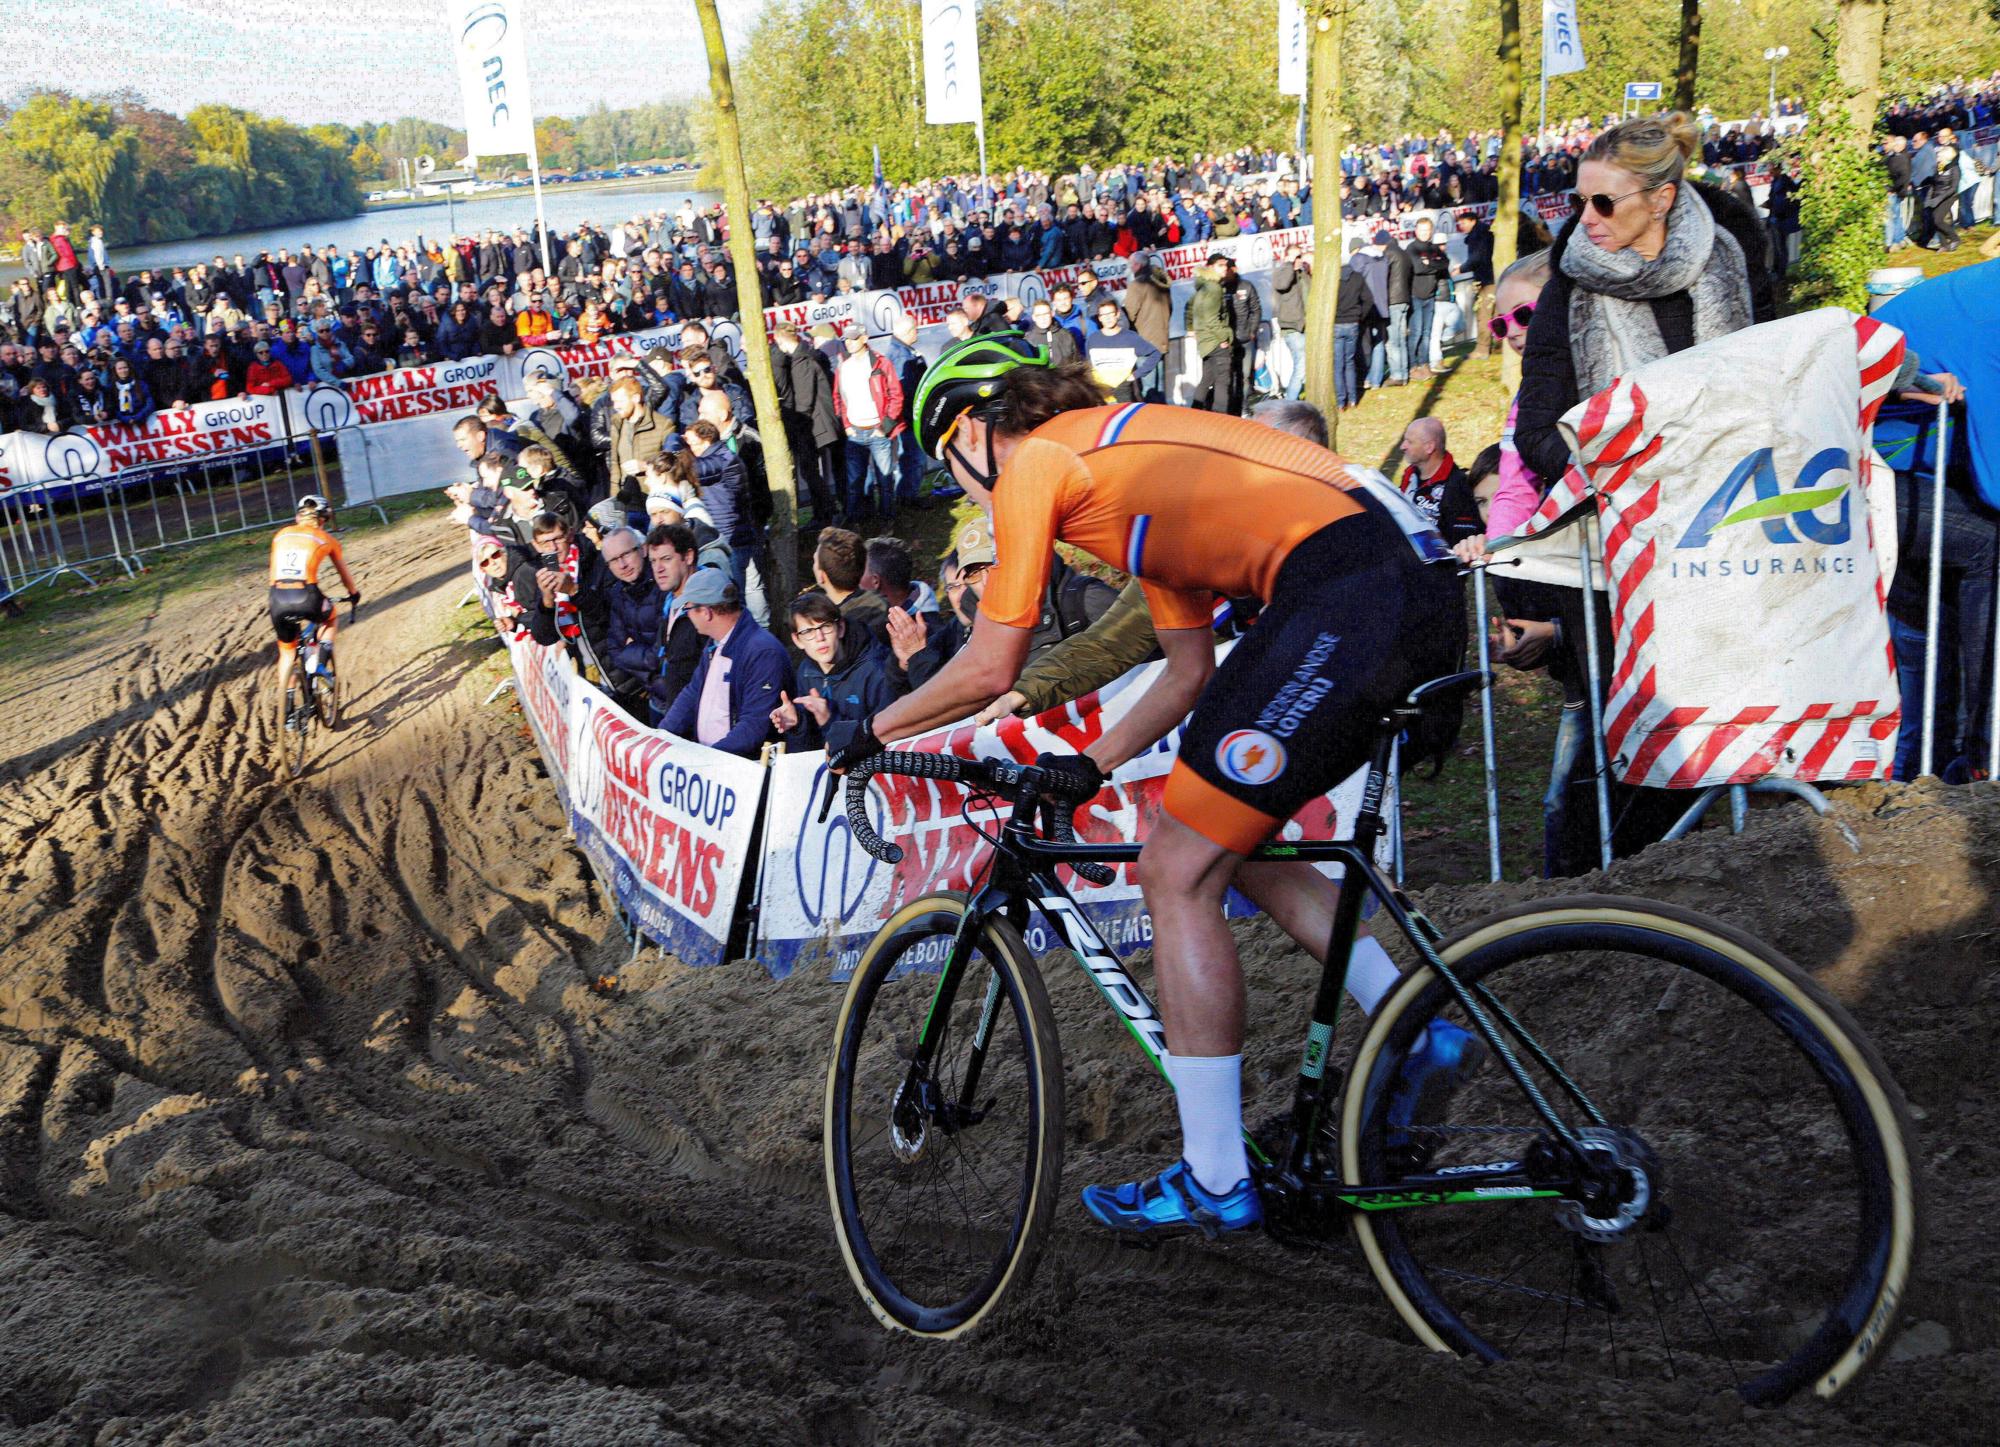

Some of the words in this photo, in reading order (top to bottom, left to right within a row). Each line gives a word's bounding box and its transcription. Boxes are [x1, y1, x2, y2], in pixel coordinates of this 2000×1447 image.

[1556, 12, 1573, 56] UEC
[1162, 247, 1208, 268] WILLY
[1269, 229, 1310, 249] WILLY
[1097, 264, 1127, 278] GROUP
[813, 303, 852, 321] GROUP
[898, 283, 960, 308] WILLY
[553, 336, 635, 367] WILLY
[347, 366, 437, 403] WILLY
[443, 362, 494, 384] GROUP
[354, 379, 500, 425] NAESSENS
[86, 408, 196, 449] WILLY
[204, 403, 265, 428] GROUP
[105, 421, 273, 473] NAESSENS
[1675, 447, 1852, 550] AG
[1671, 556, 1855, 579] INSURANCE
[1254, 631, 1342, 729] NEDERLANDSE
[1271, 677, 1335, 738] LOTERIJ
[660, 761, 736, 831] GROUP
